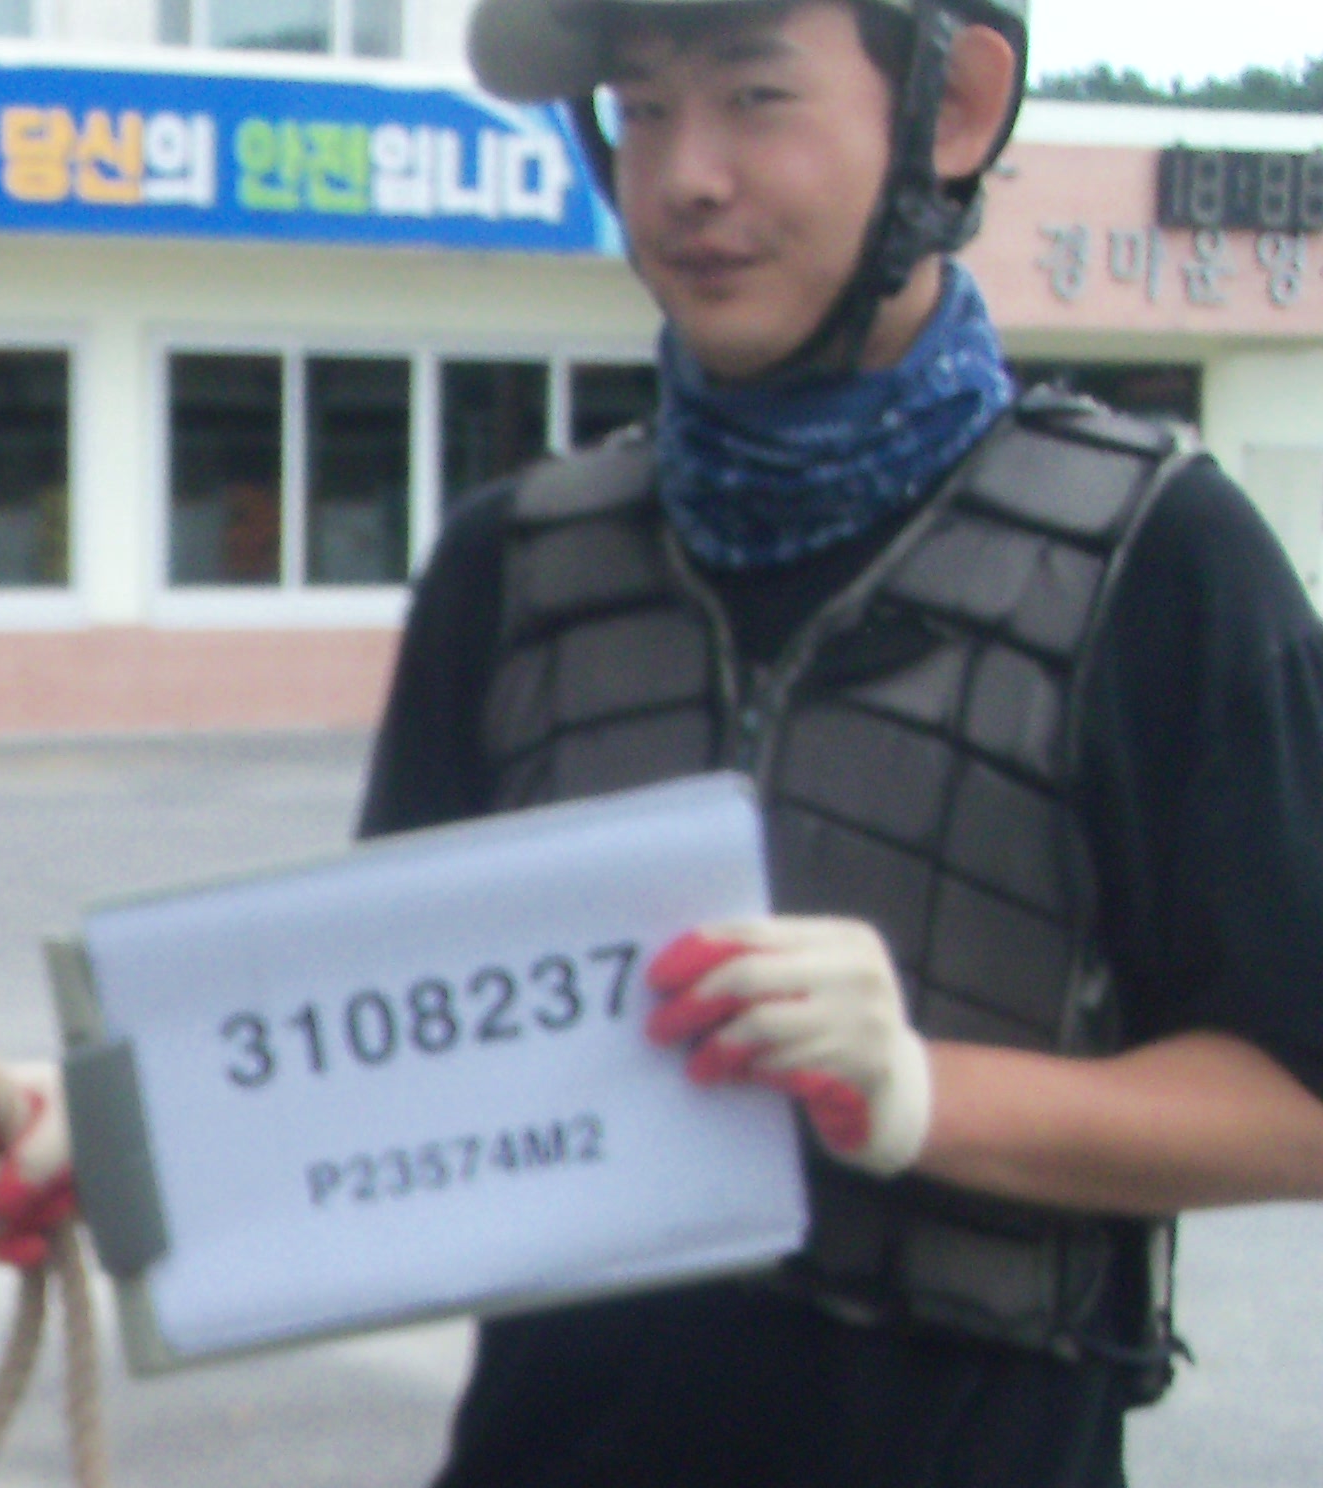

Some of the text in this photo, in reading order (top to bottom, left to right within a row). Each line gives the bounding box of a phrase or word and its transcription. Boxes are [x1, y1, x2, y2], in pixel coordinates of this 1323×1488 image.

[235, 117, 572, 223] 안전입니다
[218, 939, 643, 1088] 3108237
[306, 1114, 605, 1206] P23574M2
